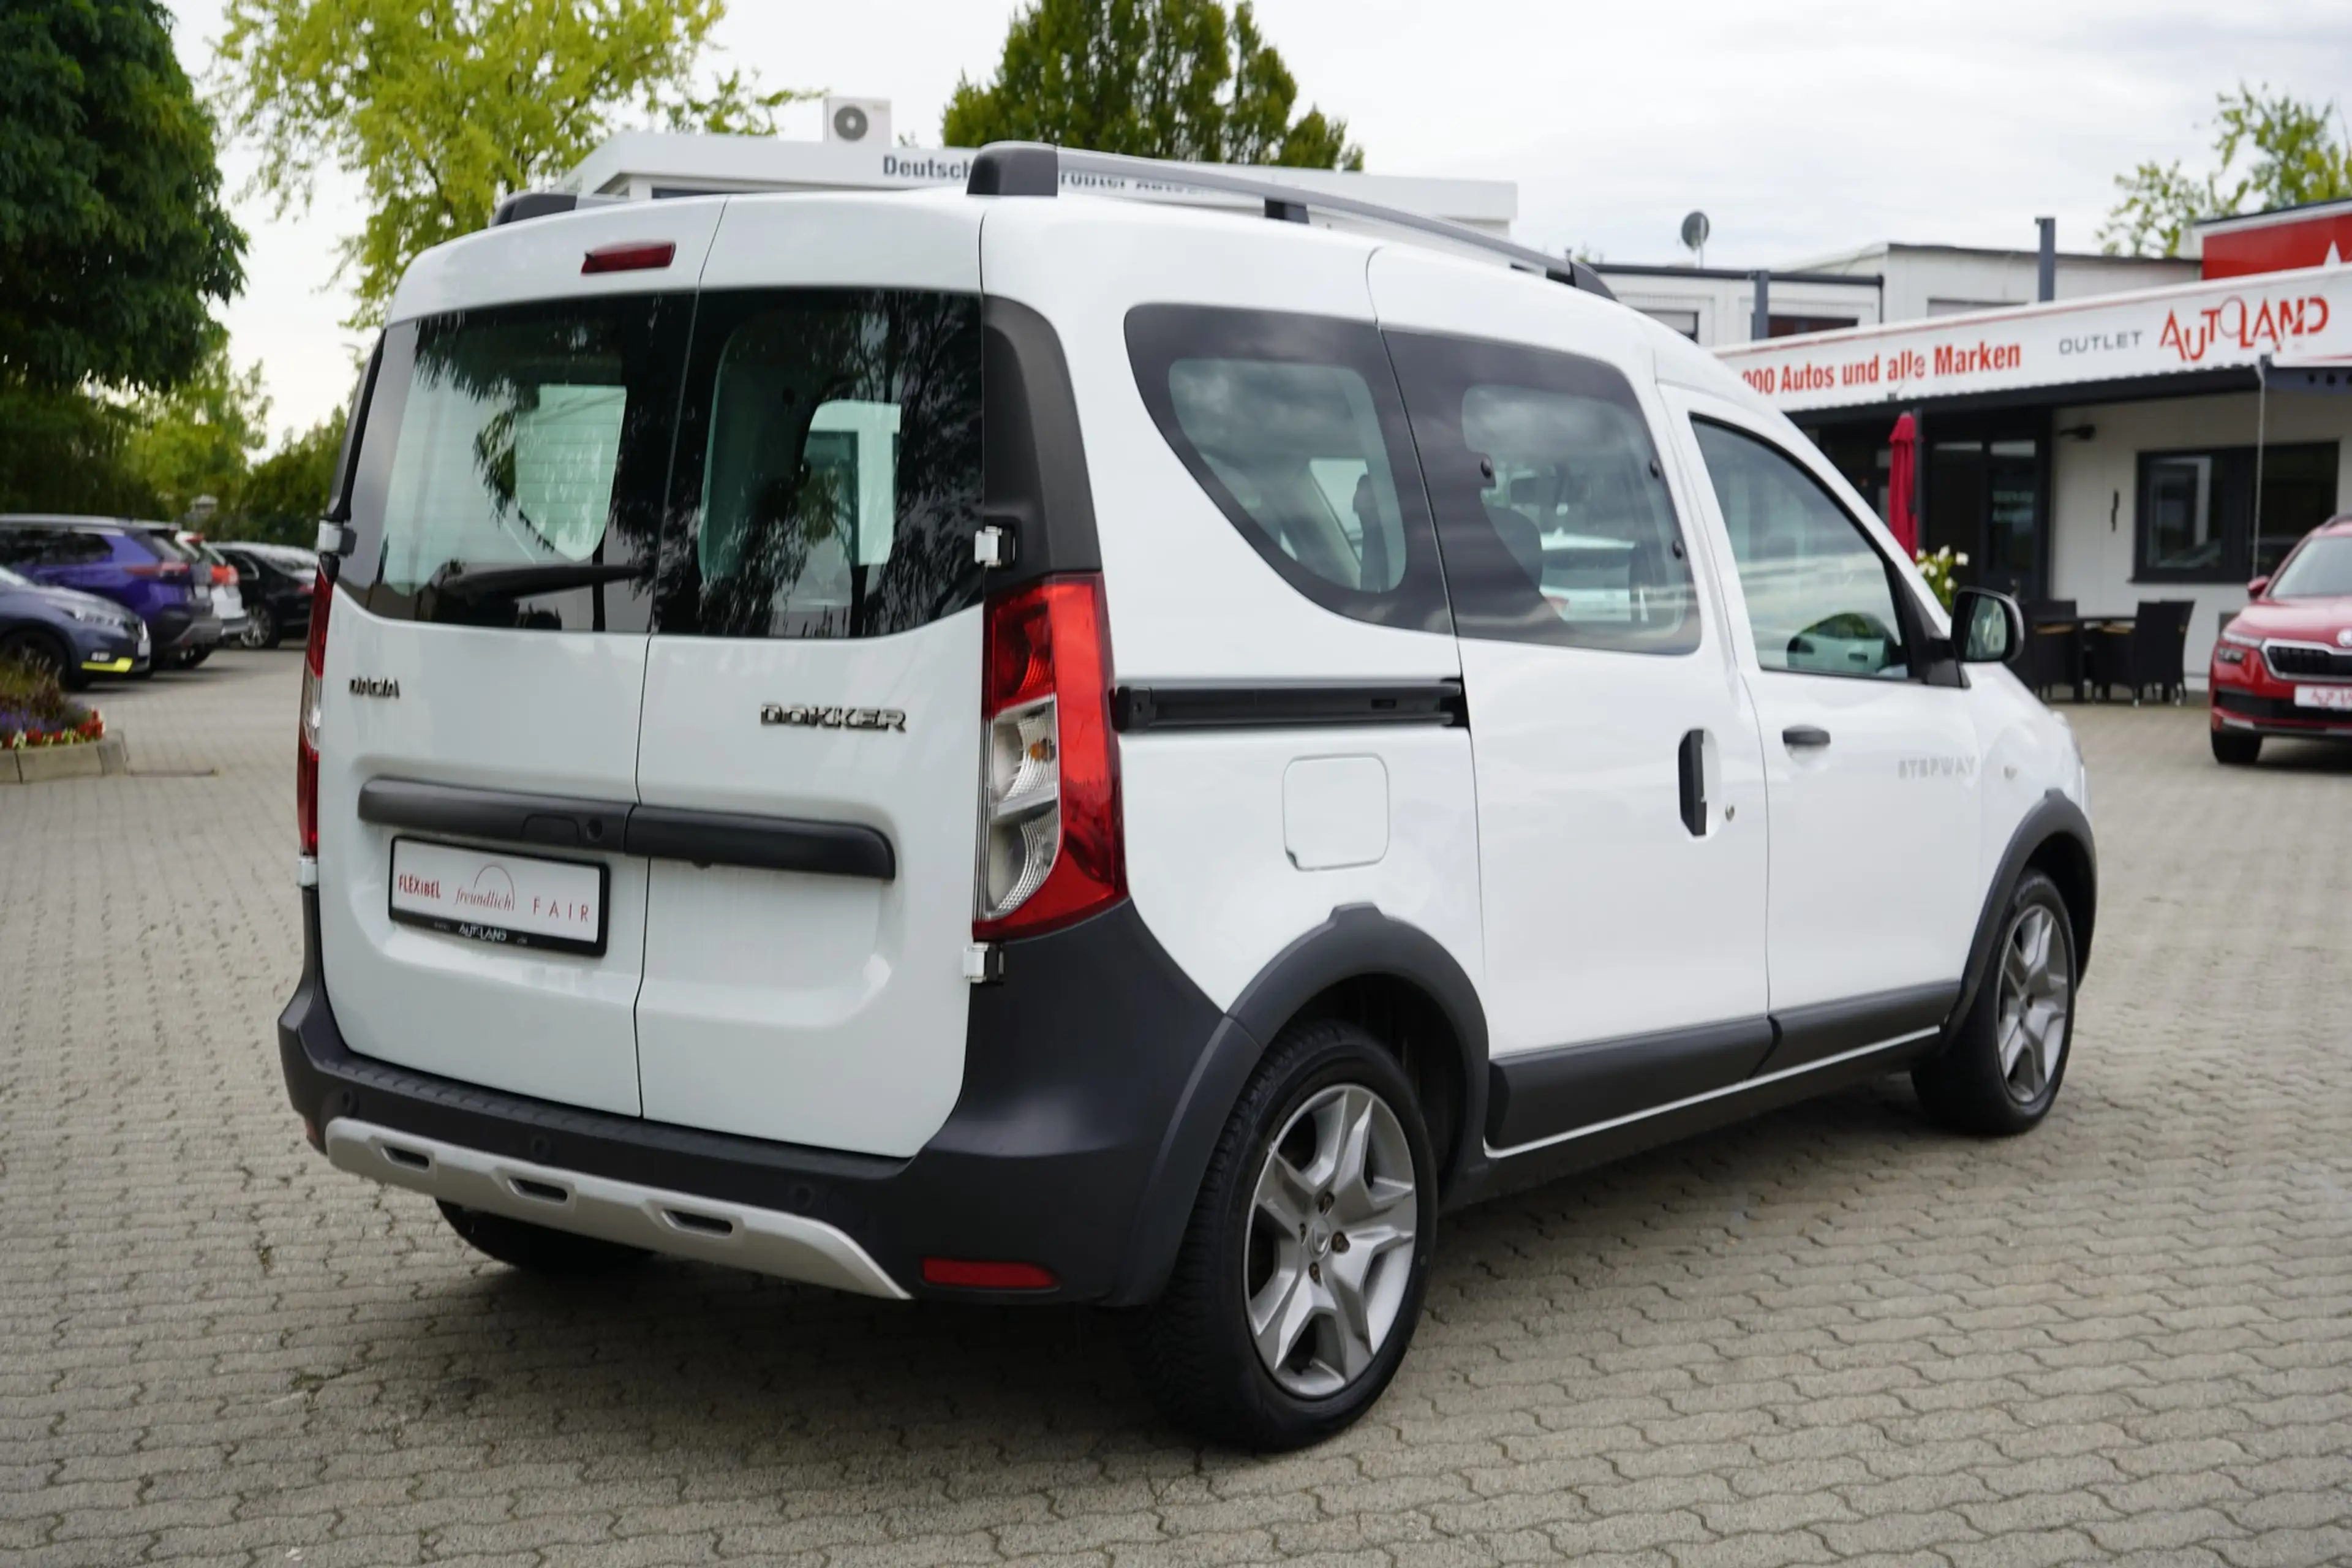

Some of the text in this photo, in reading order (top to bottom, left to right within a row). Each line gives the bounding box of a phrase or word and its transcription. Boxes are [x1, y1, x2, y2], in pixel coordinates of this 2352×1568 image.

[2059, 295, 2329, 362] OUTLET AUTOLAND
[1781, 361, 1835, 393] Autos
[1842, 353, 1880, 387] und
[1887, 348, 1926, 382] alle
[1934, 340, 2021, 377] Marken
[348, 676, 400, 699] DACIA
[761, 703, 907, 734] DOKKER
[398, 873, 441, 900] FLEXIBEL
[454, 886, 513, 912] freundlich
